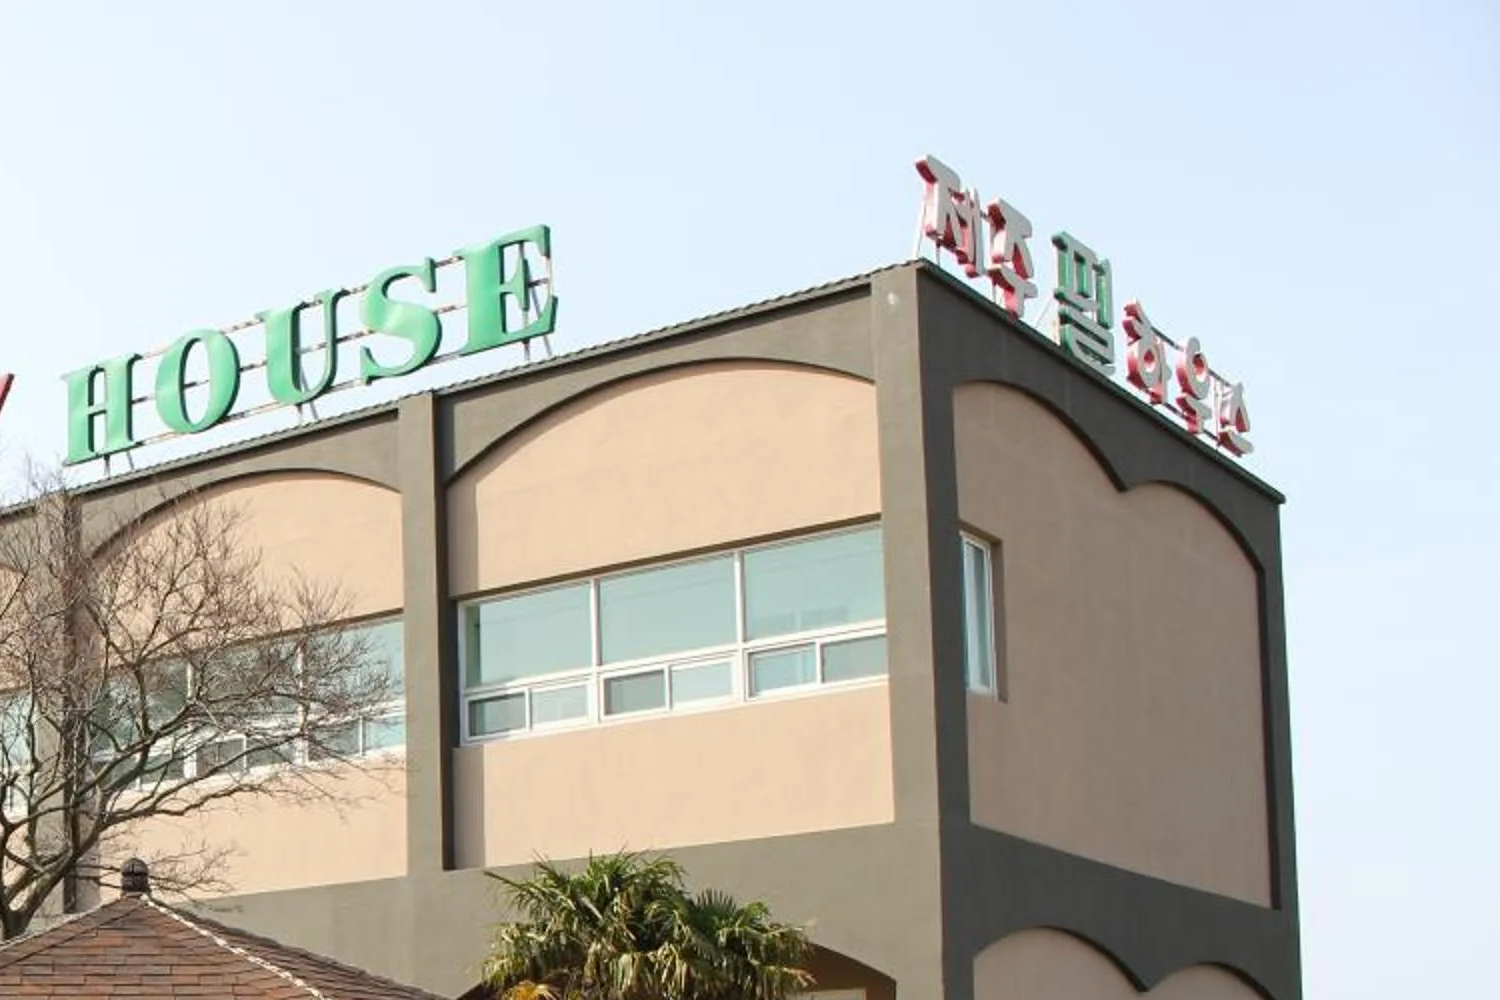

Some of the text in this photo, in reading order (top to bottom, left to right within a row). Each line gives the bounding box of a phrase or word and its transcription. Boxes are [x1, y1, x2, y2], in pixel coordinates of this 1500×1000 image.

[60, 224, 559, 467] HOUSE
[915, 154, 1254, 458] 제주 필 하우스
